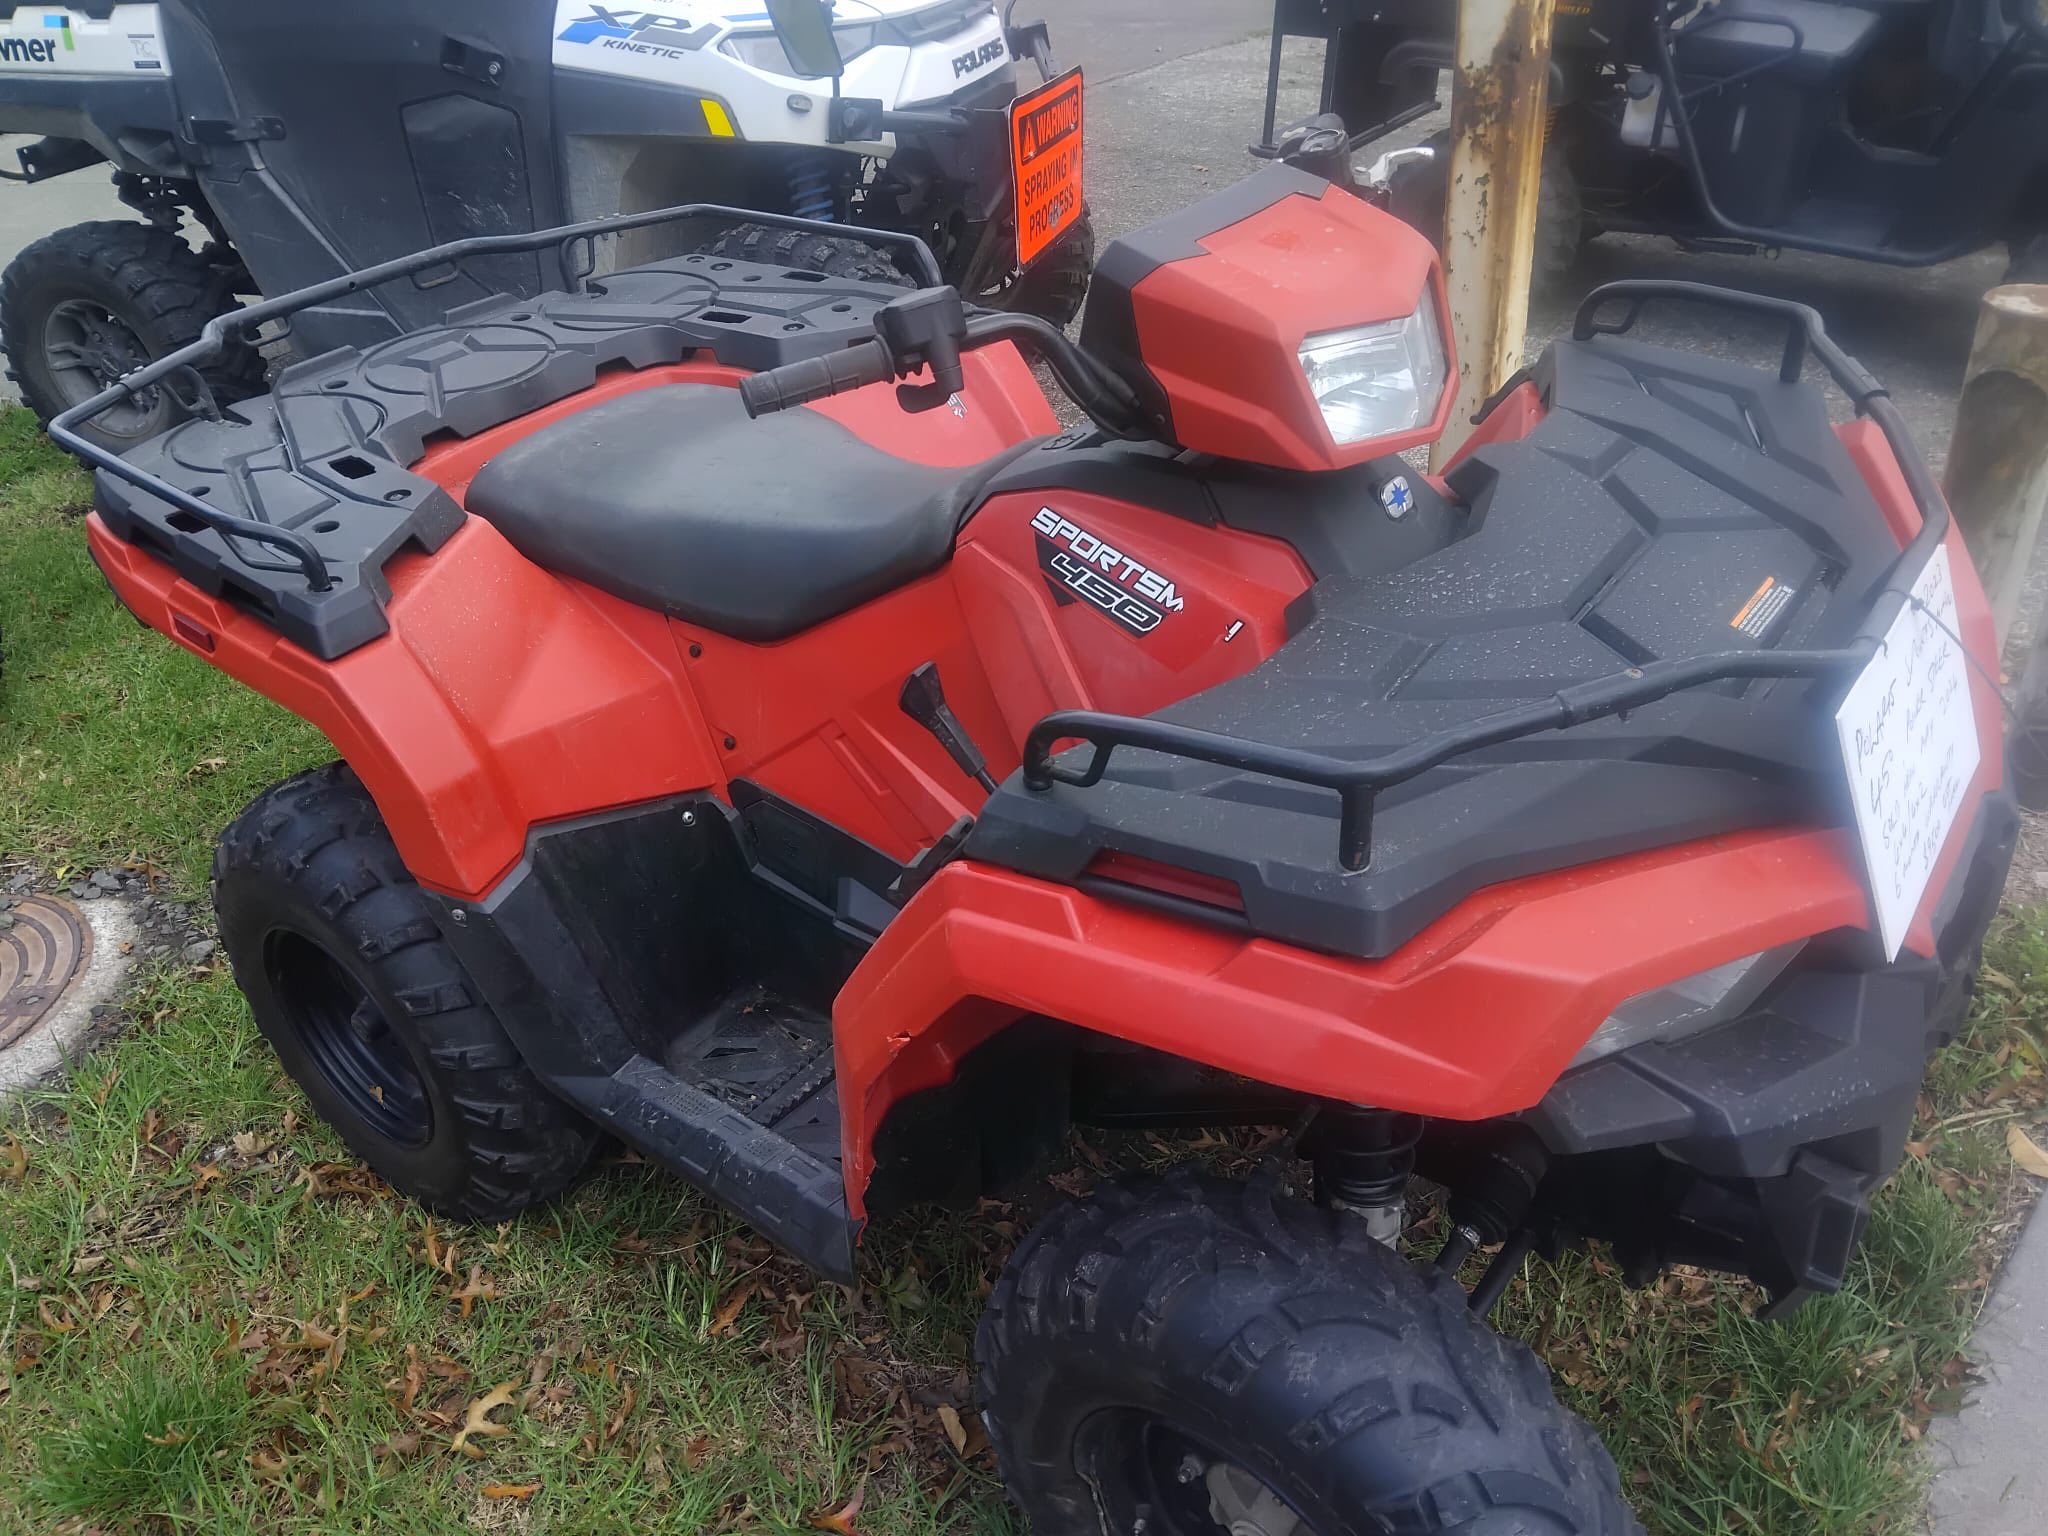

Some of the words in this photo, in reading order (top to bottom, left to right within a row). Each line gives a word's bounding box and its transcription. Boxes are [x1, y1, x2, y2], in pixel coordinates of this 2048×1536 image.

[570, 4, 692, 31] XP
[602, 39, 684, 60] KINETIC
[952, 36, 1004, 79] POLARIS
[1037, 94, 1077, 146] WARNING
[1025, 152, 1067, 207] SPRAYING
[1070, 144, 1078, 174] IN
[1030, 183, 1074, 242] PROGRESS
[1051, 552, 1162, 632] 450
